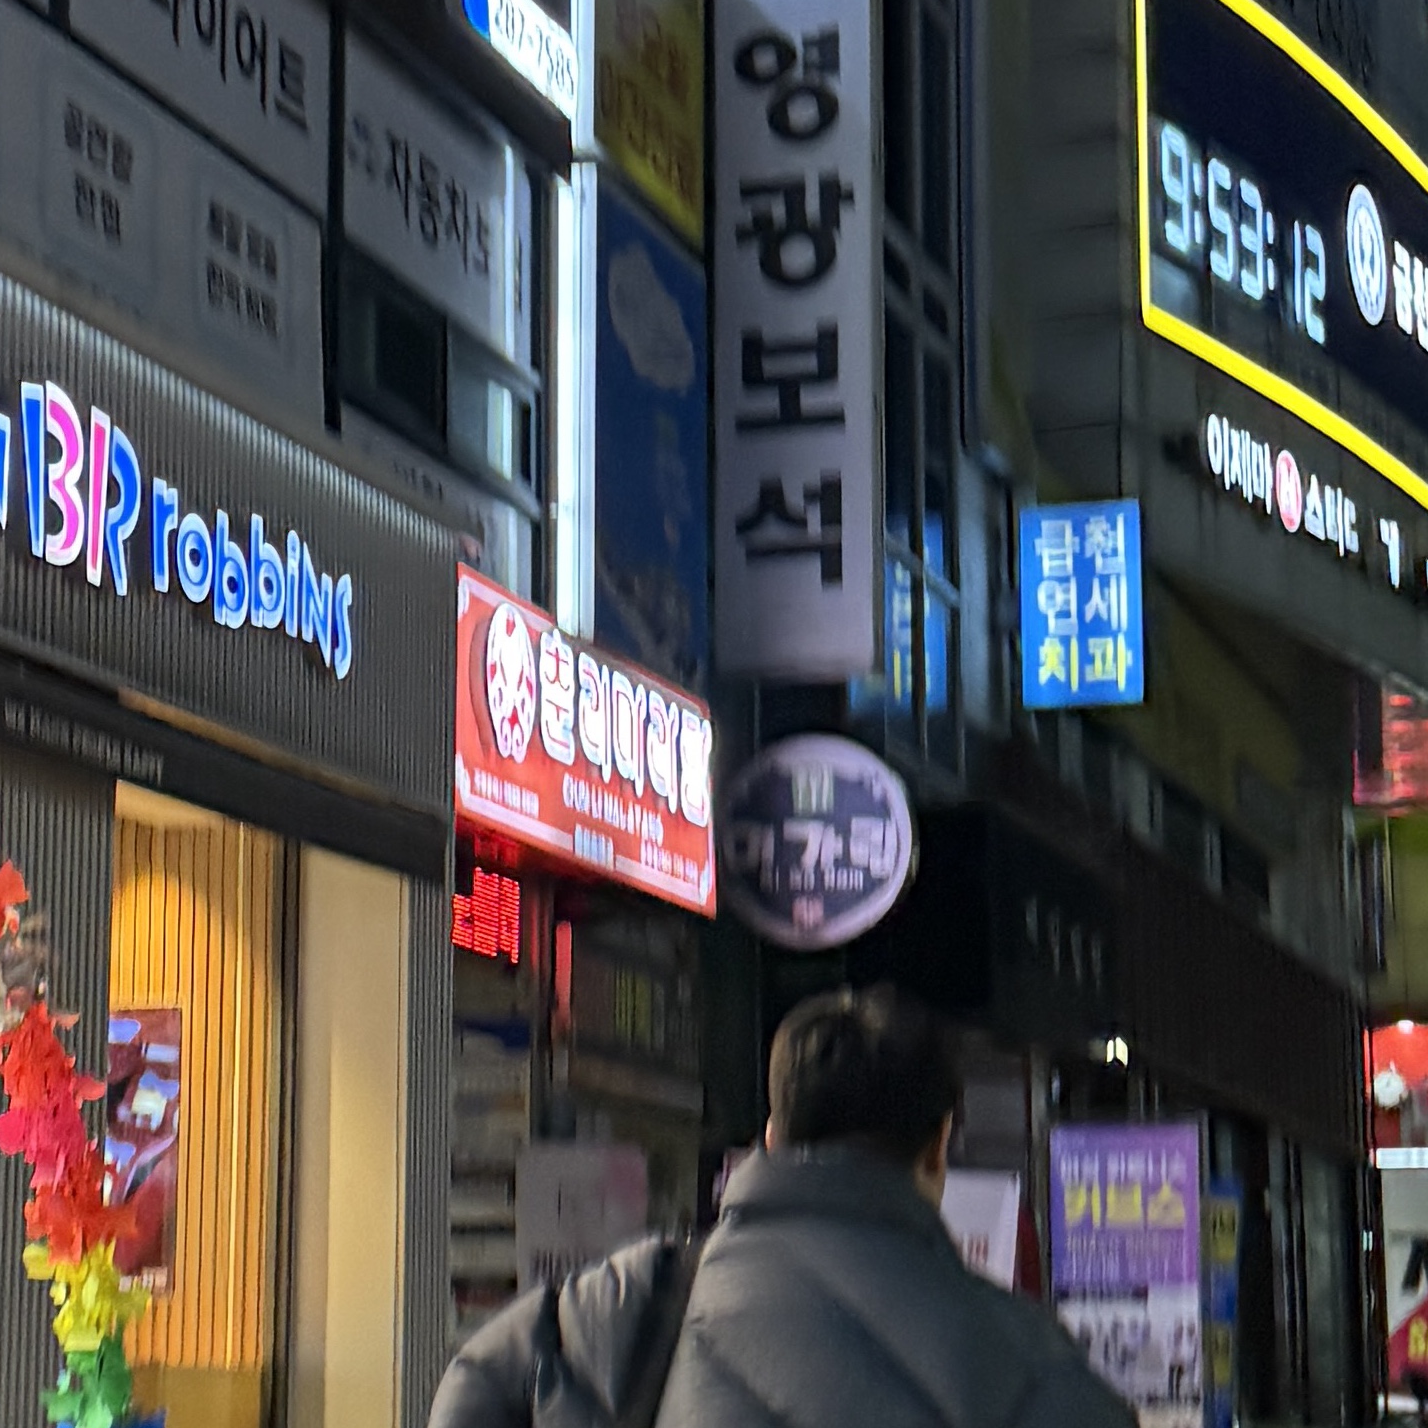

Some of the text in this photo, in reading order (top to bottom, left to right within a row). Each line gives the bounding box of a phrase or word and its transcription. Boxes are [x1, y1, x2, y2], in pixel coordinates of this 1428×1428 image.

[734, 22, 856, 592] 영광보석
[1159, 121, 1329, 348] 9:53:12
[20, 379, 142, 598] BR
[152, 476, 354, 682] robbins
